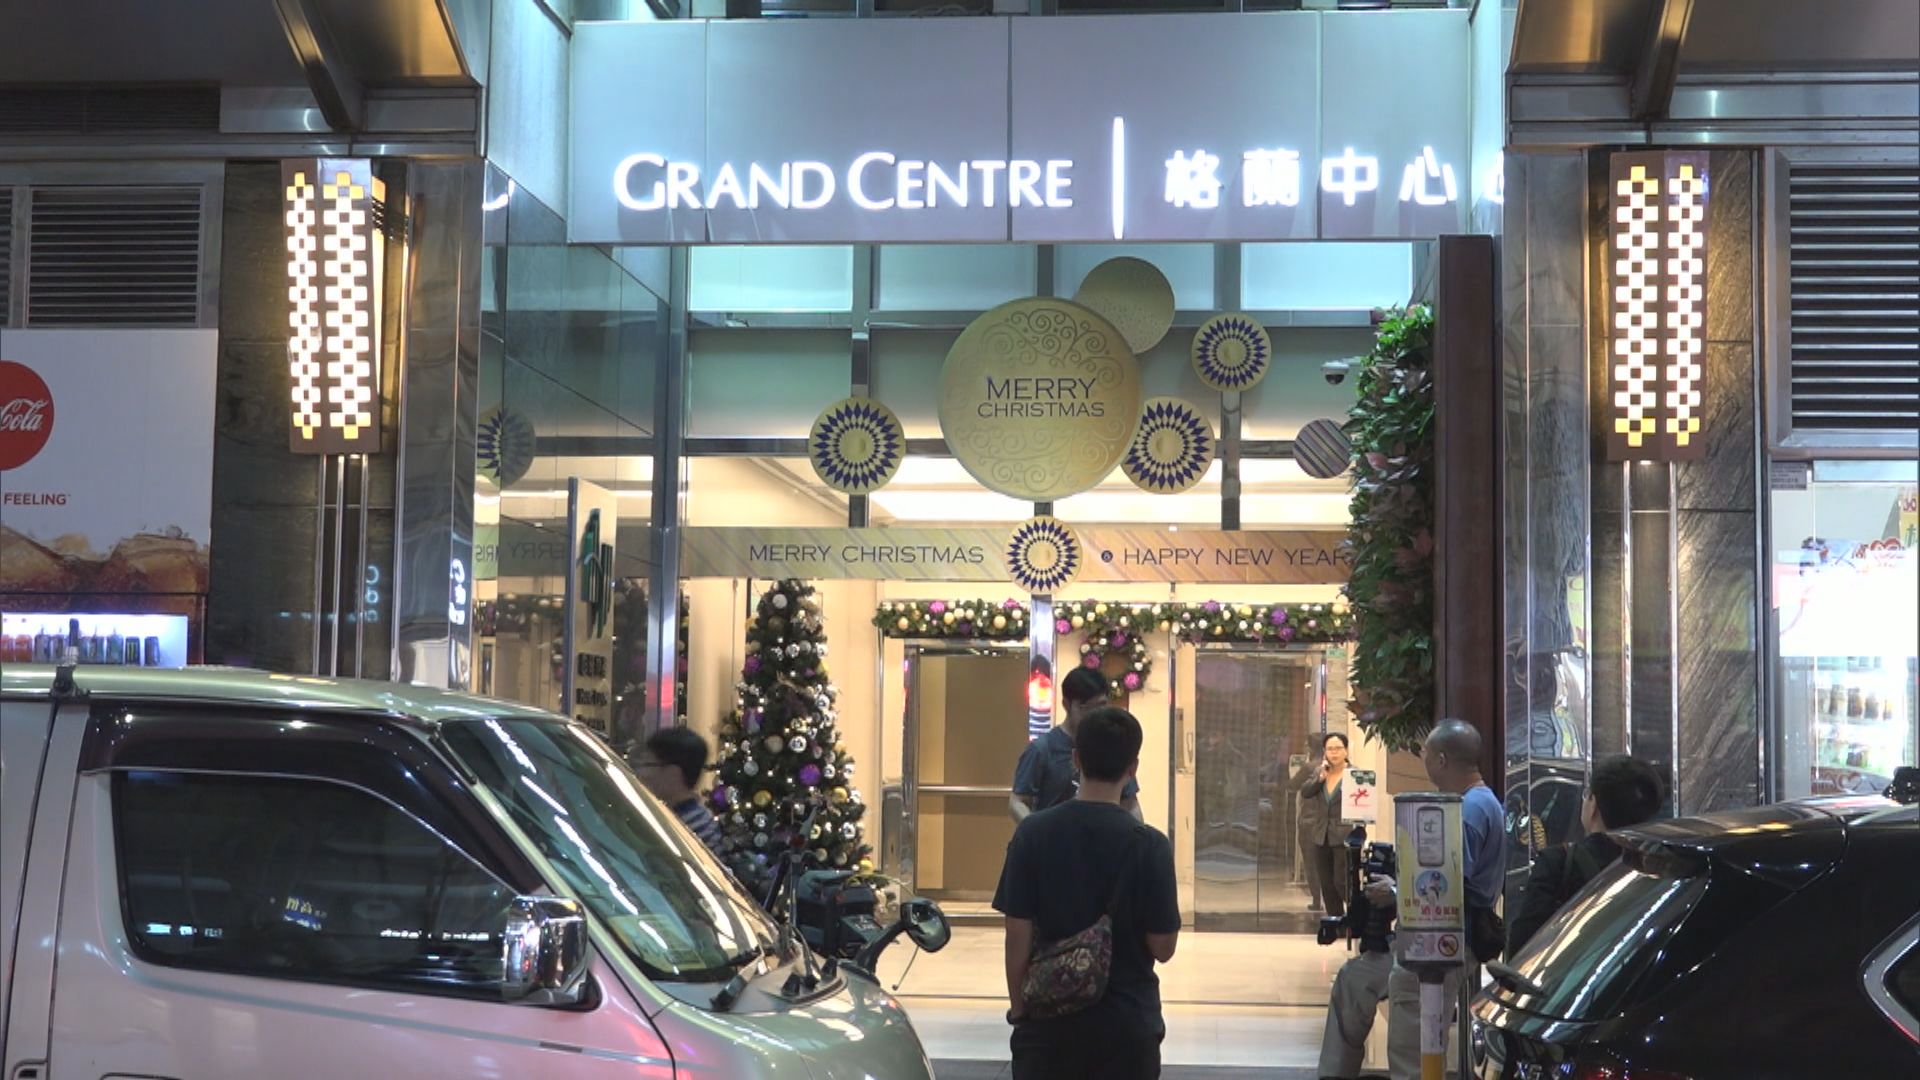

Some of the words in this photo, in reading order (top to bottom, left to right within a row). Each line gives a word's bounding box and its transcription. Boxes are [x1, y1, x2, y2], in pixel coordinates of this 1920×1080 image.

[614, 153, 836, 210] GRAND
[847, 152, 1073, 210] CENTRE
[1165, 146, 1459, 208] 格蘭中心
[987, 377, 1096, 400] MERRY
[977, 402, 1105, 418] CHRISTMAS
[4, 493, 67, 505] FEELING
[750, 545, 831, 562] MERRY
[841, 546, 985, 564] CHRISTMAS
[1124, 548, 1204, 565] HAPPY
[1215, 548, 1274, 565] NEW
